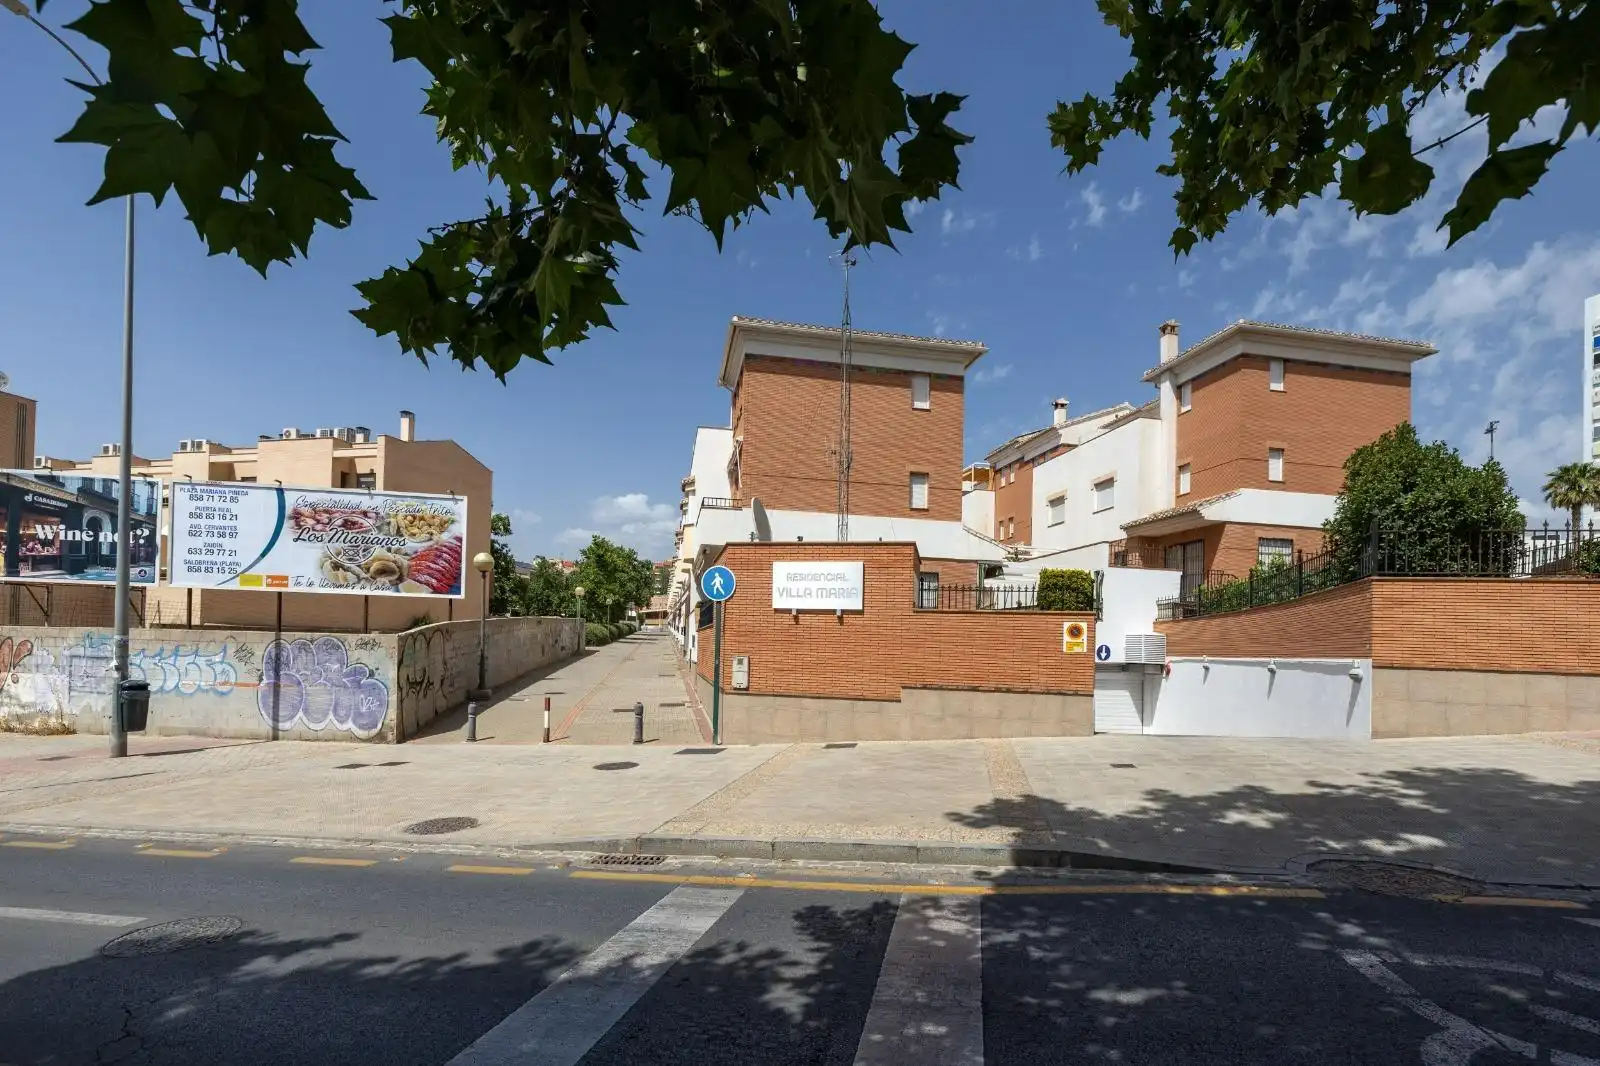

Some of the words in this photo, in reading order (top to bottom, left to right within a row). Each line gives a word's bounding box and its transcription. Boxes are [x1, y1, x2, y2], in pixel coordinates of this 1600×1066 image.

[189, 494, 204, 502] 858
[230, 496, 240, 504] 85
[295, 496, 363, 512] Especialidad
[382, 499, 424, 513] Pescado
[427, 503, 452, 516] Frito
[189, 512, 204, 520] 858
[35, 524, 94, 542] Wine
[188, 529, 203, 538] 622
[205, 530, 215, 538] 73
[217, 531, 227, 539] 58
[229, 531, 239, 539] 97
[293, 527, 325, 543] Los
[325, 528, 408, 547] Marianos
[187, 547, 203, 556] 633
[205, 548, 215, 556] 29
[216, 549, 227, 557] 77
[228, 549, 238, 557] 21
[187, 565, 202, 573] 858
[228, 567, 238, 575] 25
[786, 572, 850, 582] RESIDENCIAL
[292, 575, 305, 588] Te
[306, 577, 315, 588] lo
[319, 577, 356, 590] llevamos
[777, 587, 813, 599] VILLA
[816, 587, 860, 599] MARIA
